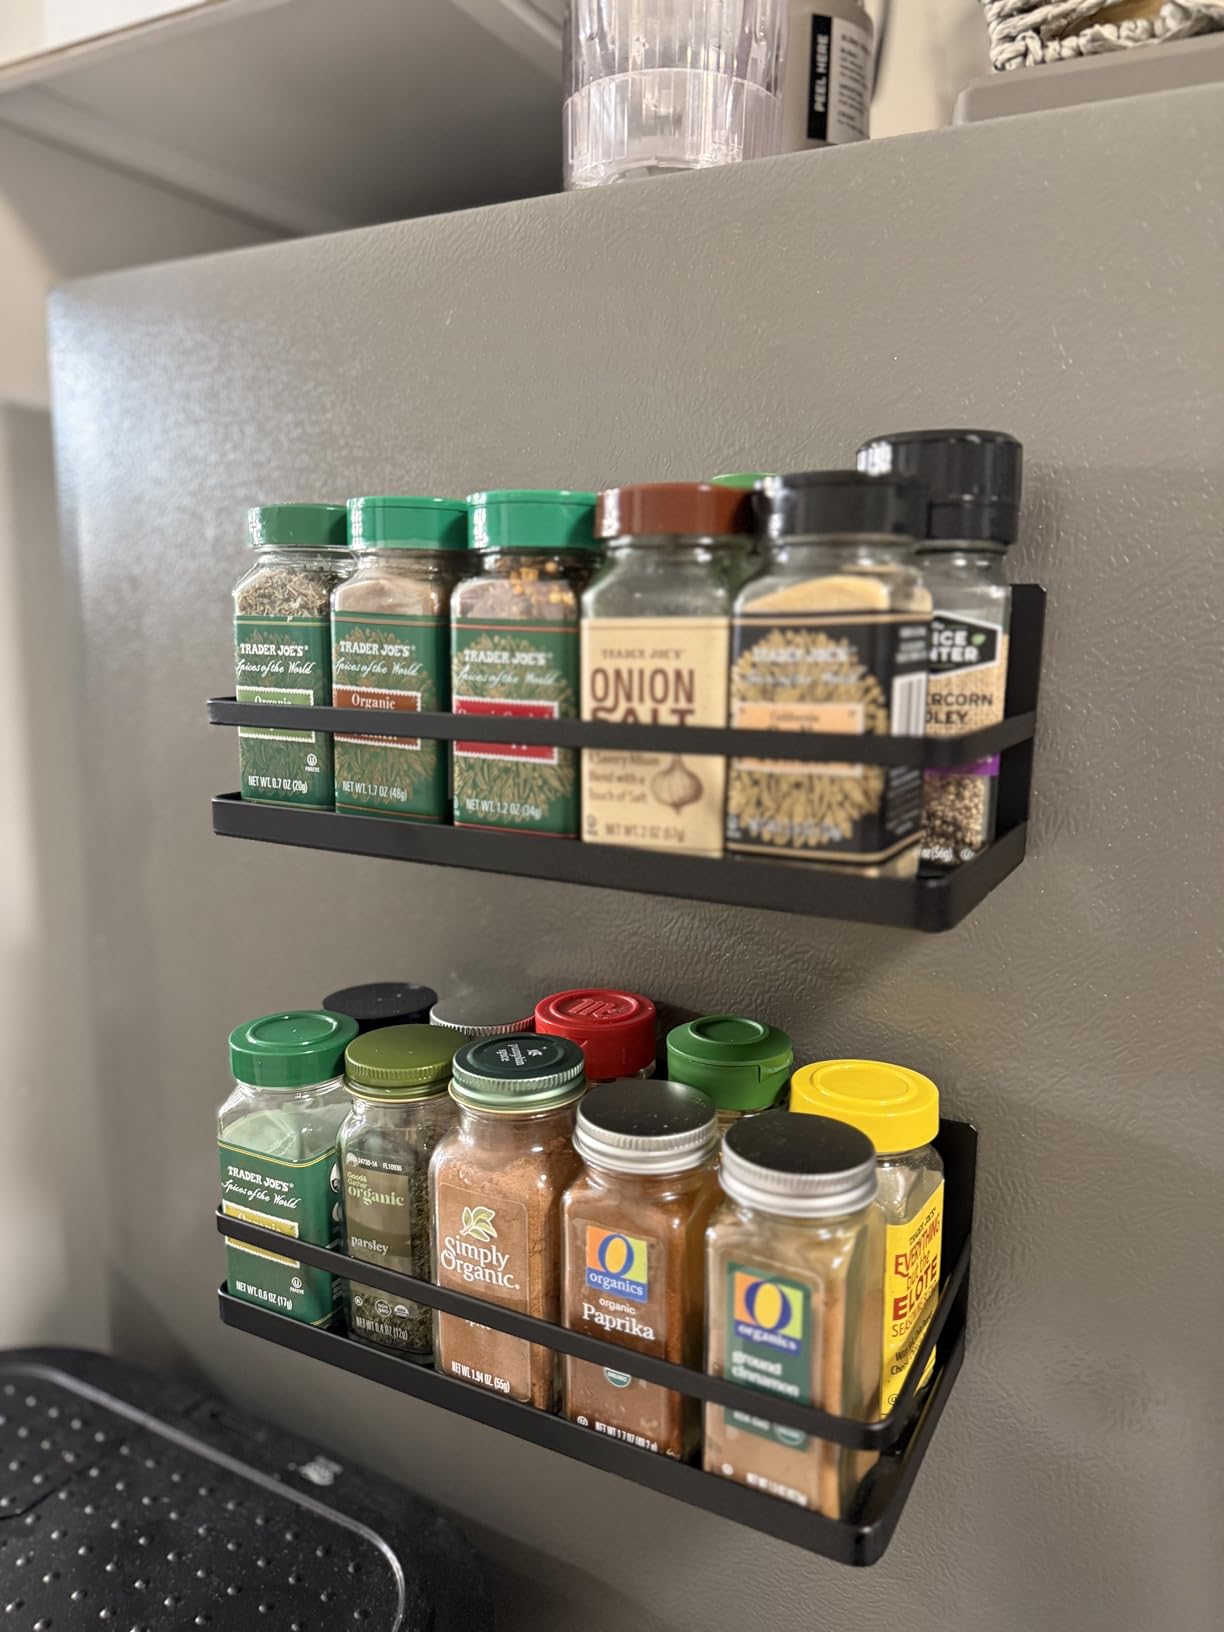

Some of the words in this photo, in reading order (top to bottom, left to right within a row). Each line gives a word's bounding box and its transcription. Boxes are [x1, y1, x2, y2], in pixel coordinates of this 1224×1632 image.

[815, 33, 829, 73] HERE
[813, 76, 828, 112] PEEL
[239, 643, 277, 656] TRADER
[277, 645, 305, 657] JOE'S
[339, 641, 380, 655] TRADER
[380, 644, 411, 658] JOE'S
[463, 649, 510, 664] TRADER
[602, 648, 646, 660] TRADER
[288, 661, 317, 675] World
[391, 661, 424, 676] World
[590, 667, 695, 705] ONION
[351, 693, 396, 710] Organic
[248, 775, 260, 787] NET
[272, 777, 281, 789] 0.7
[283, 779, 292, 790] OZ
[292, 780, 308, 794] (20g)
[342, 780, 354, 792] NET
[368, 784, 378, 796] 1.7
[380, 786, 389, 797] OZ
[389, 786, 408, 802] (48g)
[466, 799, 479, 811] NET
[227, 1165, 263, 1185] TRADER
[263, 1176, 289, 1192] JOE'S
[273, 1192, 302, 1209] World
[348, 1186, 405, 1206] organic
[351, 1235, 389, 1256] parsley
[444, 1234, 511, 1272] Simply
[589, 1272, 644, 1296] organics
[893, 1254, 938, 1322] ELOTE
[236, 1280, 247, 1292] NET
[258, 1288, 268, 1301] 0.6
[268, 1292, 277, 1304] OZ
[277, 1295, 293, 1311] (17g)
[598, 1297, 637, 1316] organic
[355, 1316, 365, 1329] NET
[393, 1327, 408, 1341] (12g)
[582, 1302, 656, 1340] Paprika
[737, 1324, 798, 1351] organics
[451, 1360, 461, 1374] NET
[494, 1377, 511, 1394] (55g)
